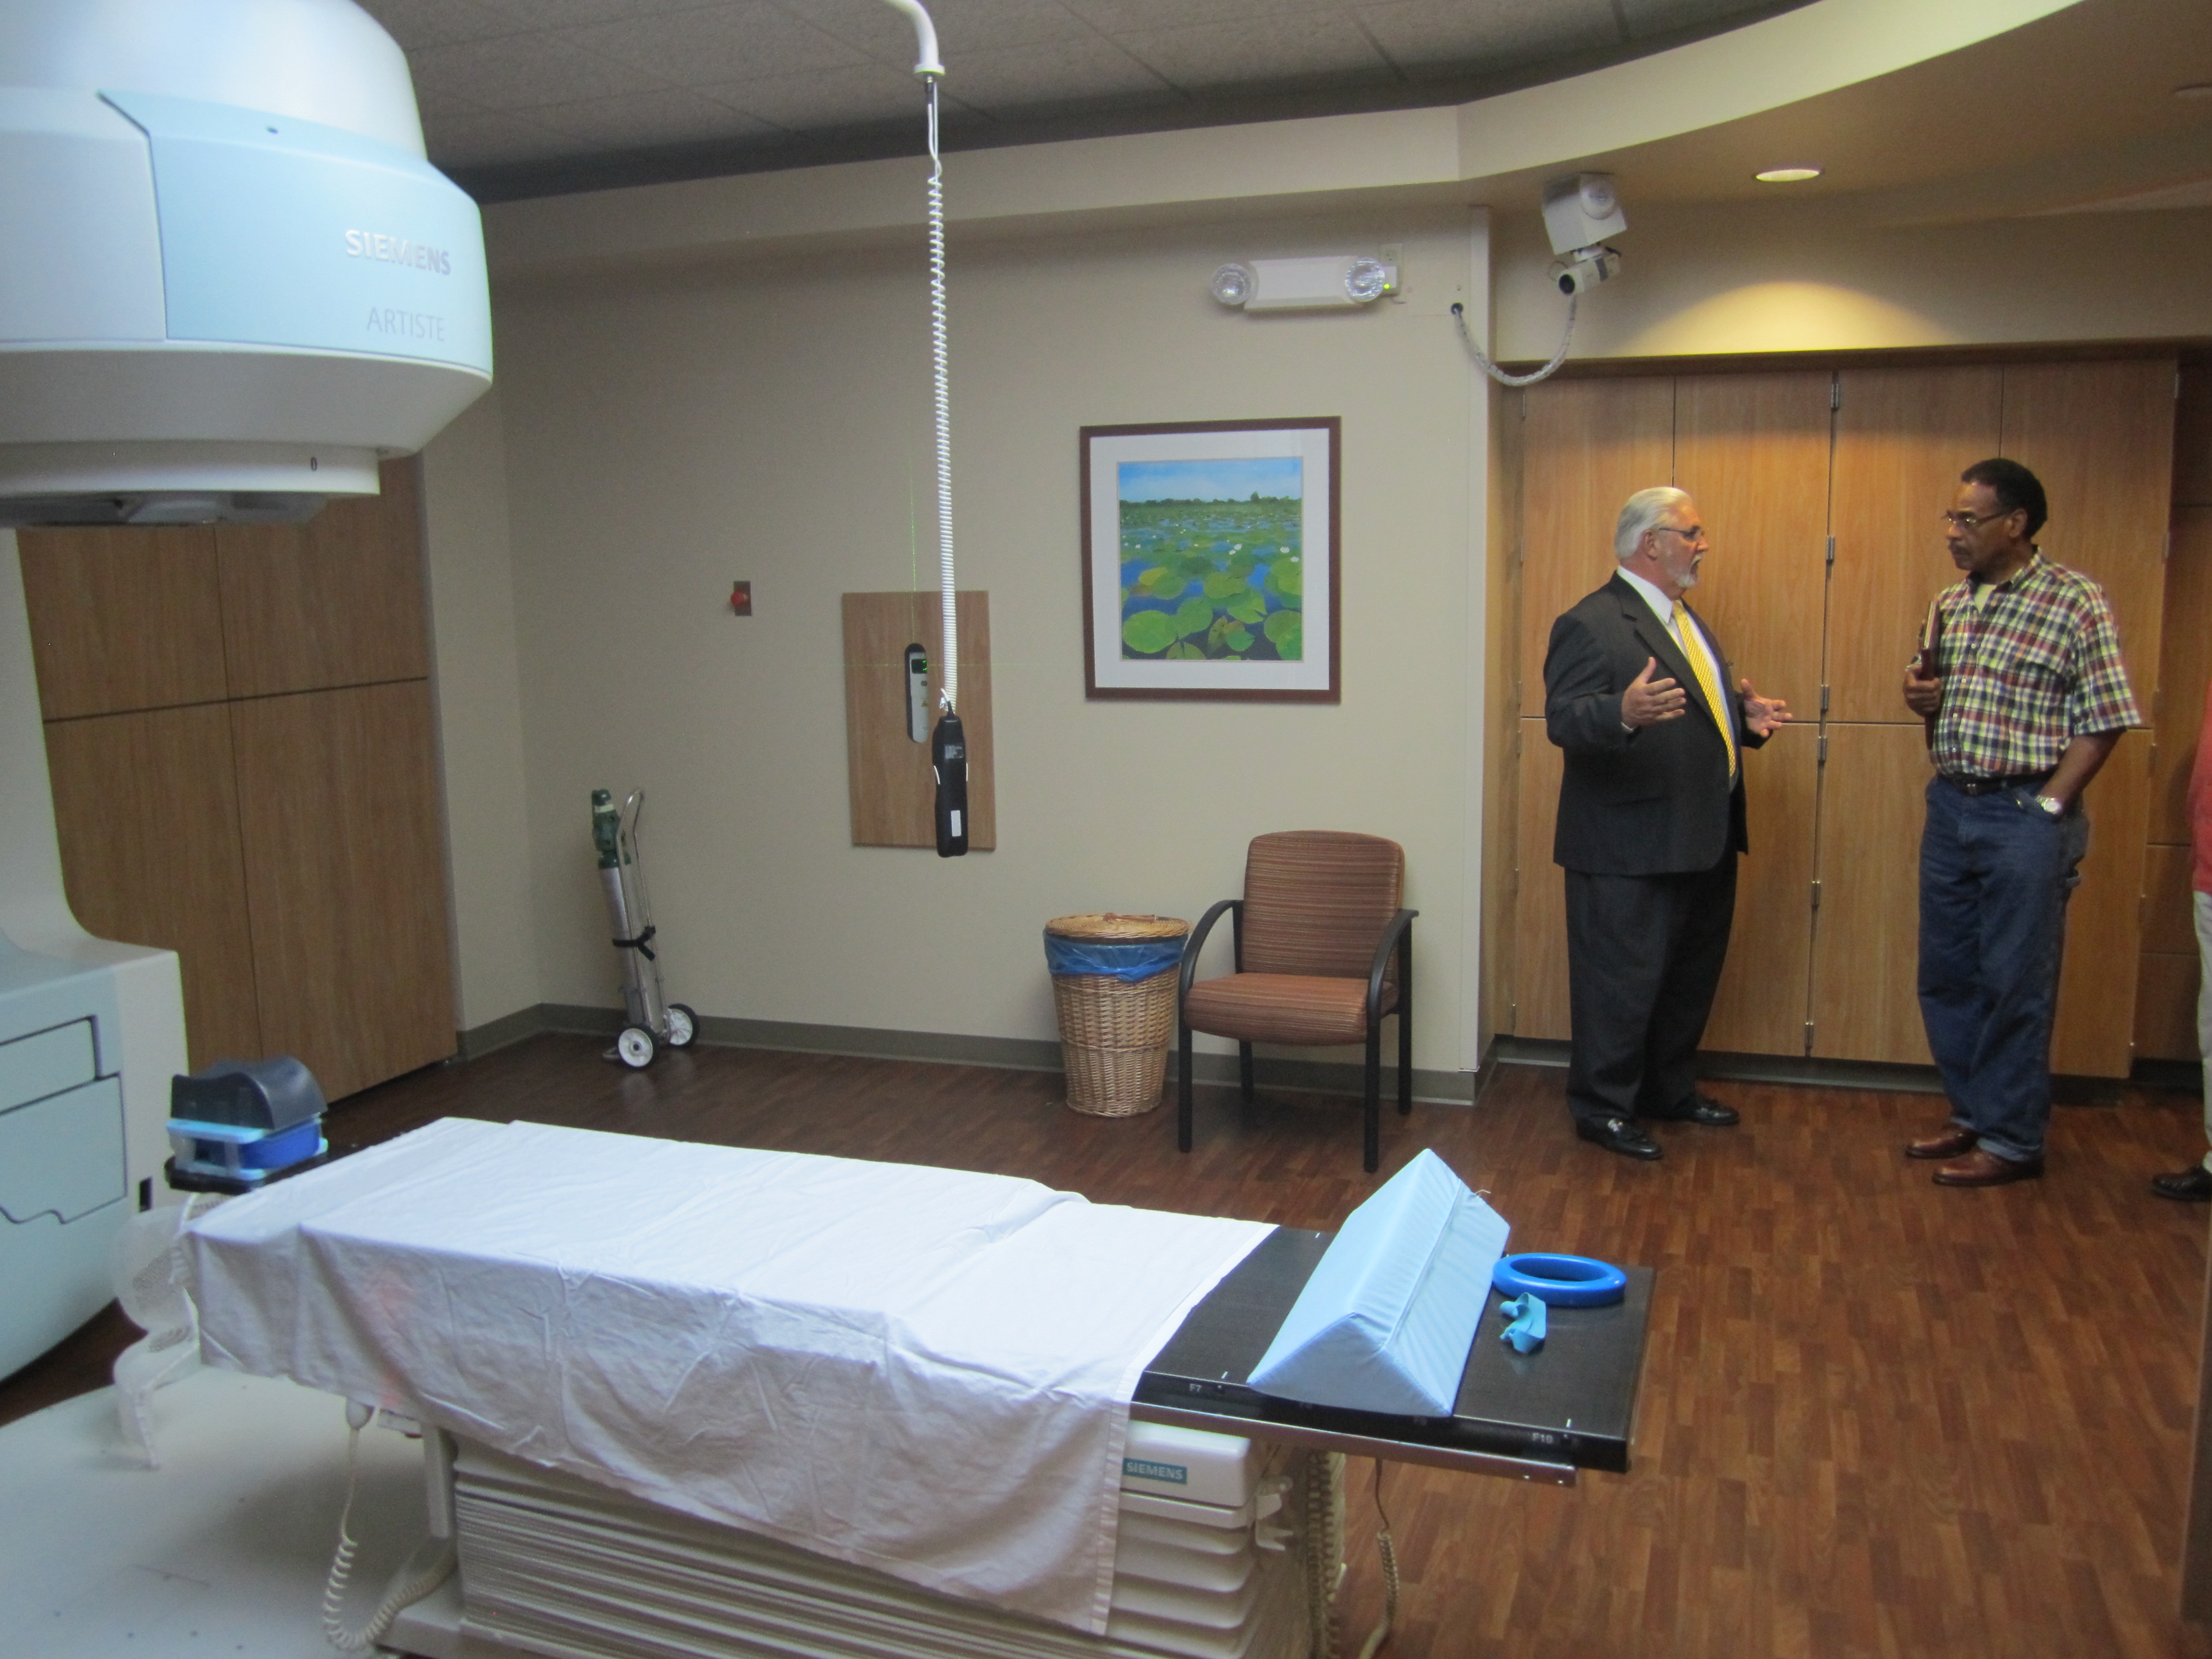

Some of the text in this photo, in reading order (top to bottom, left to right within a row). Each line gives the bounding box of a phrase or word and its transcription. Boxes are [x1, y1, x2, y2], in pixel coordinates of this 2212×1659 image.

[345, 229, 451, 275] SIEMENS
[367, 307, 445, 342] ARTISTE
[1189, 1383, 1202, 1392] F7
[1126, 1462, 1183, 1480] SIEMENS
